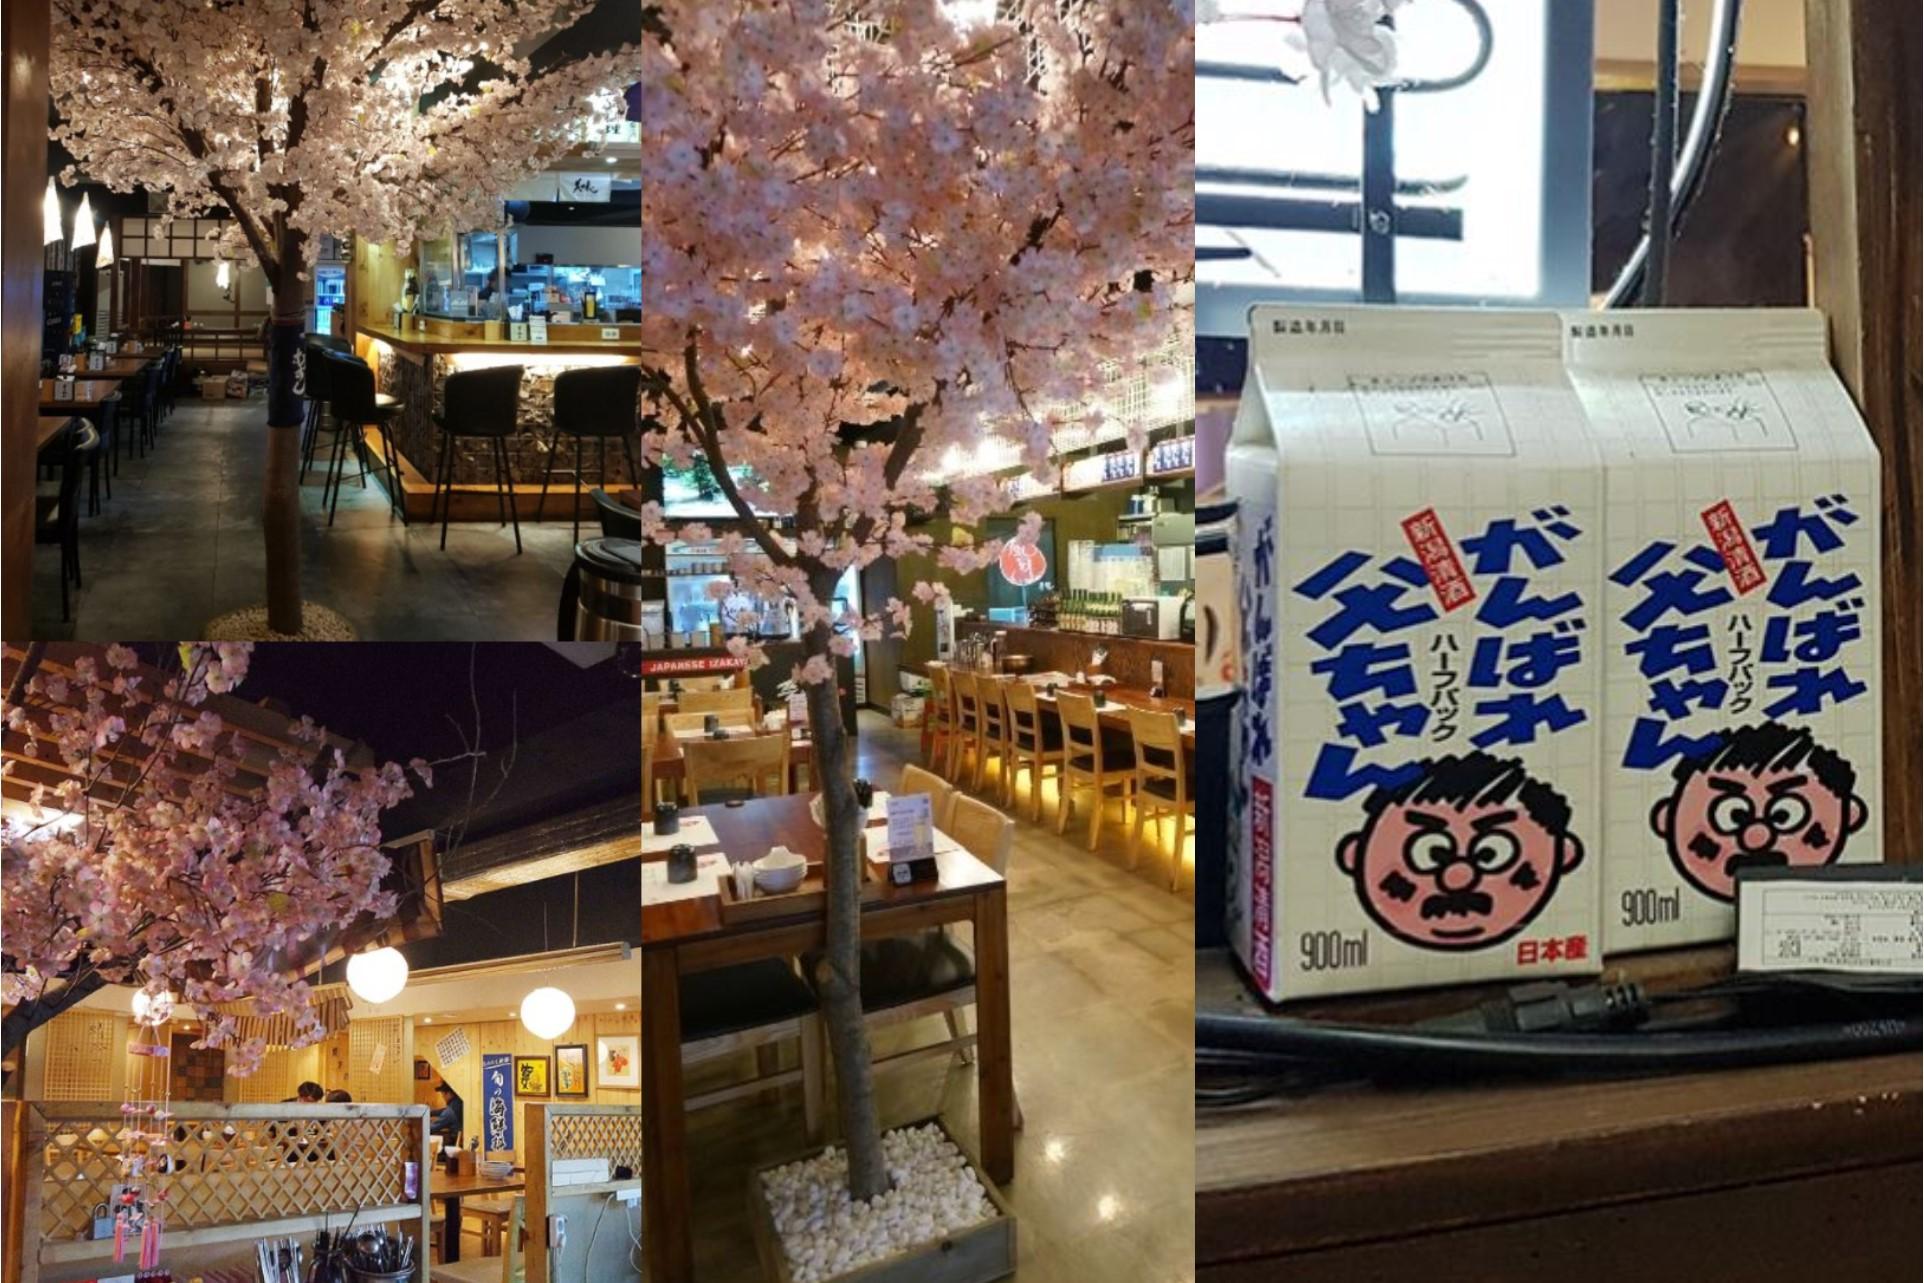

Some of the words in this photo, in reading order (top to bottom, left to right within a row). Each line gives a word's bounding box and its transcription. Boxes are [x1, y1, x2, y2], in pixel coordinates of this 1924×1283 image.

[1459, 505, 1587, 750] がんばれ
[1751, 494, 1868, 721] がんばれ
[709, 656, 747, 669] IZAKAY
[1622, 886, 1681, 927] 900ml
[1300, 928, 1369, 972] 900ml
[1515, 934, 1589, 966] 日本産
